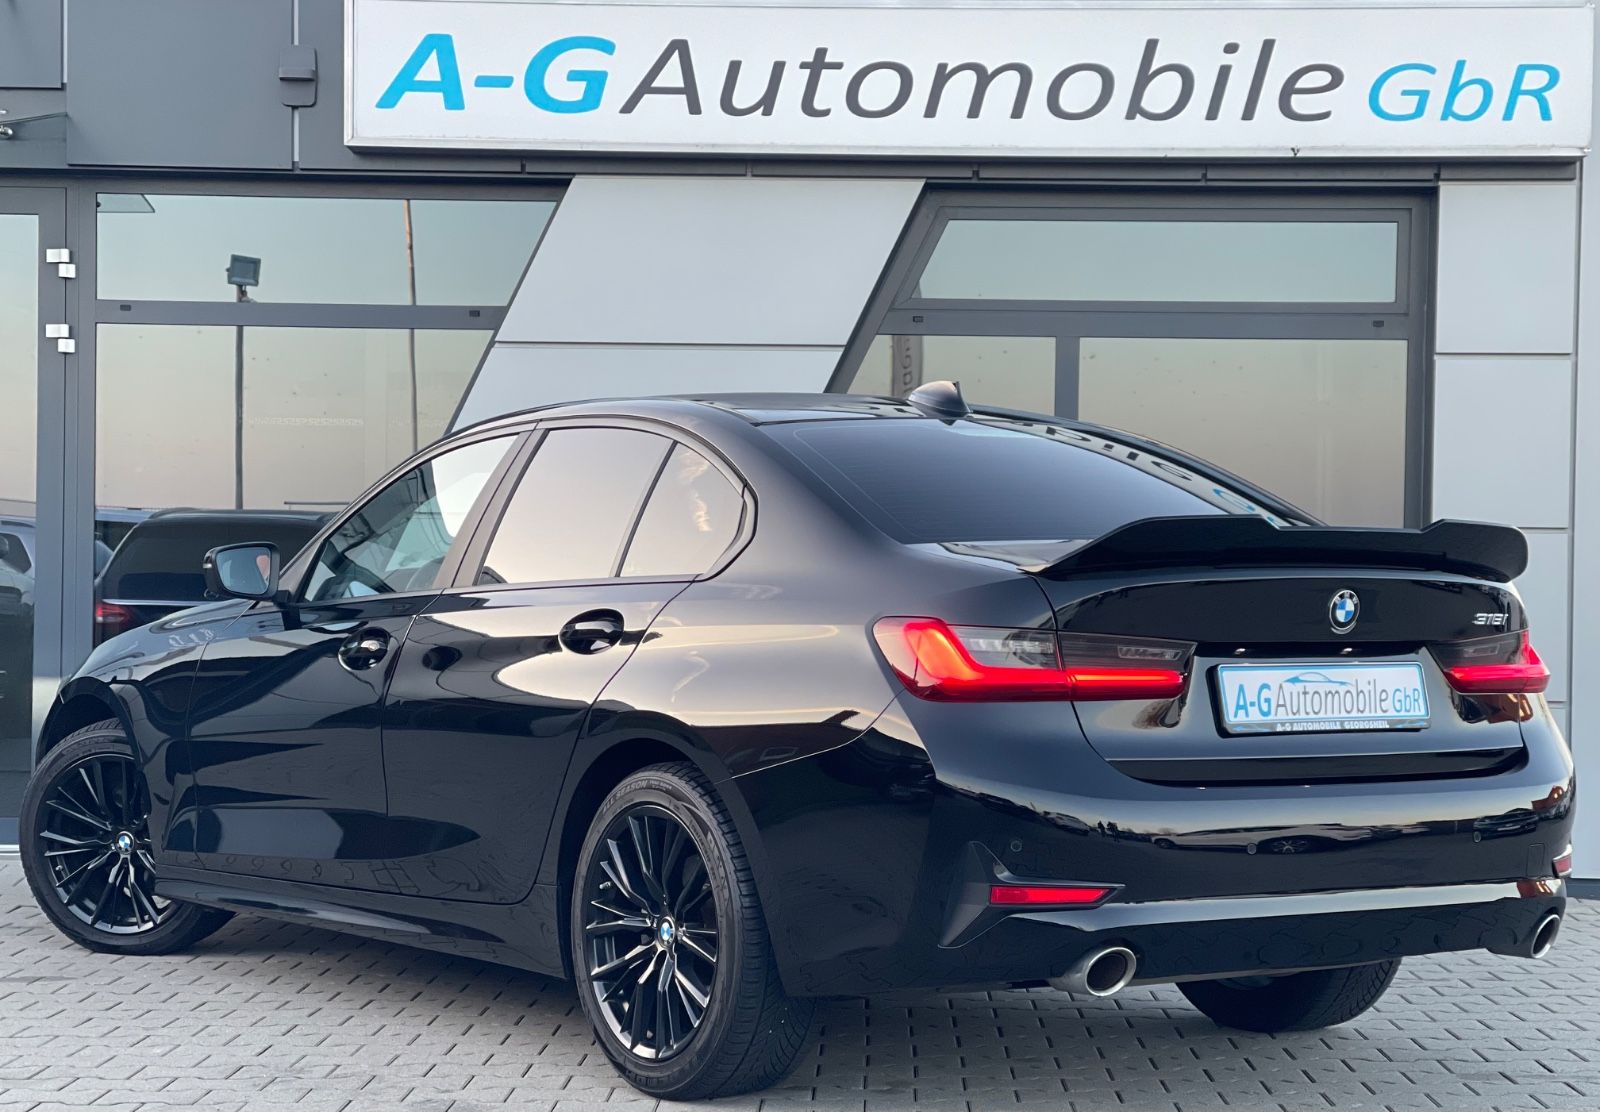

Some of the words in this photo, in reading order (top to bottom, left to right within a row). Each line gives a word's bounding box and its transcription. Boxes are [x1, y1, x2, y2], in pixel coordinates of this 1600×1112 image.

[376, 33, 616, 114] A-G
[619, 39, 1344, 122] Automobile
[1368, 59, 1560, 122] GbR
[1234, 683, 1272, 718] A-G
[1274, 679, 1389, 716] Automobile
[1392, 688, 1421, 713] GbR
